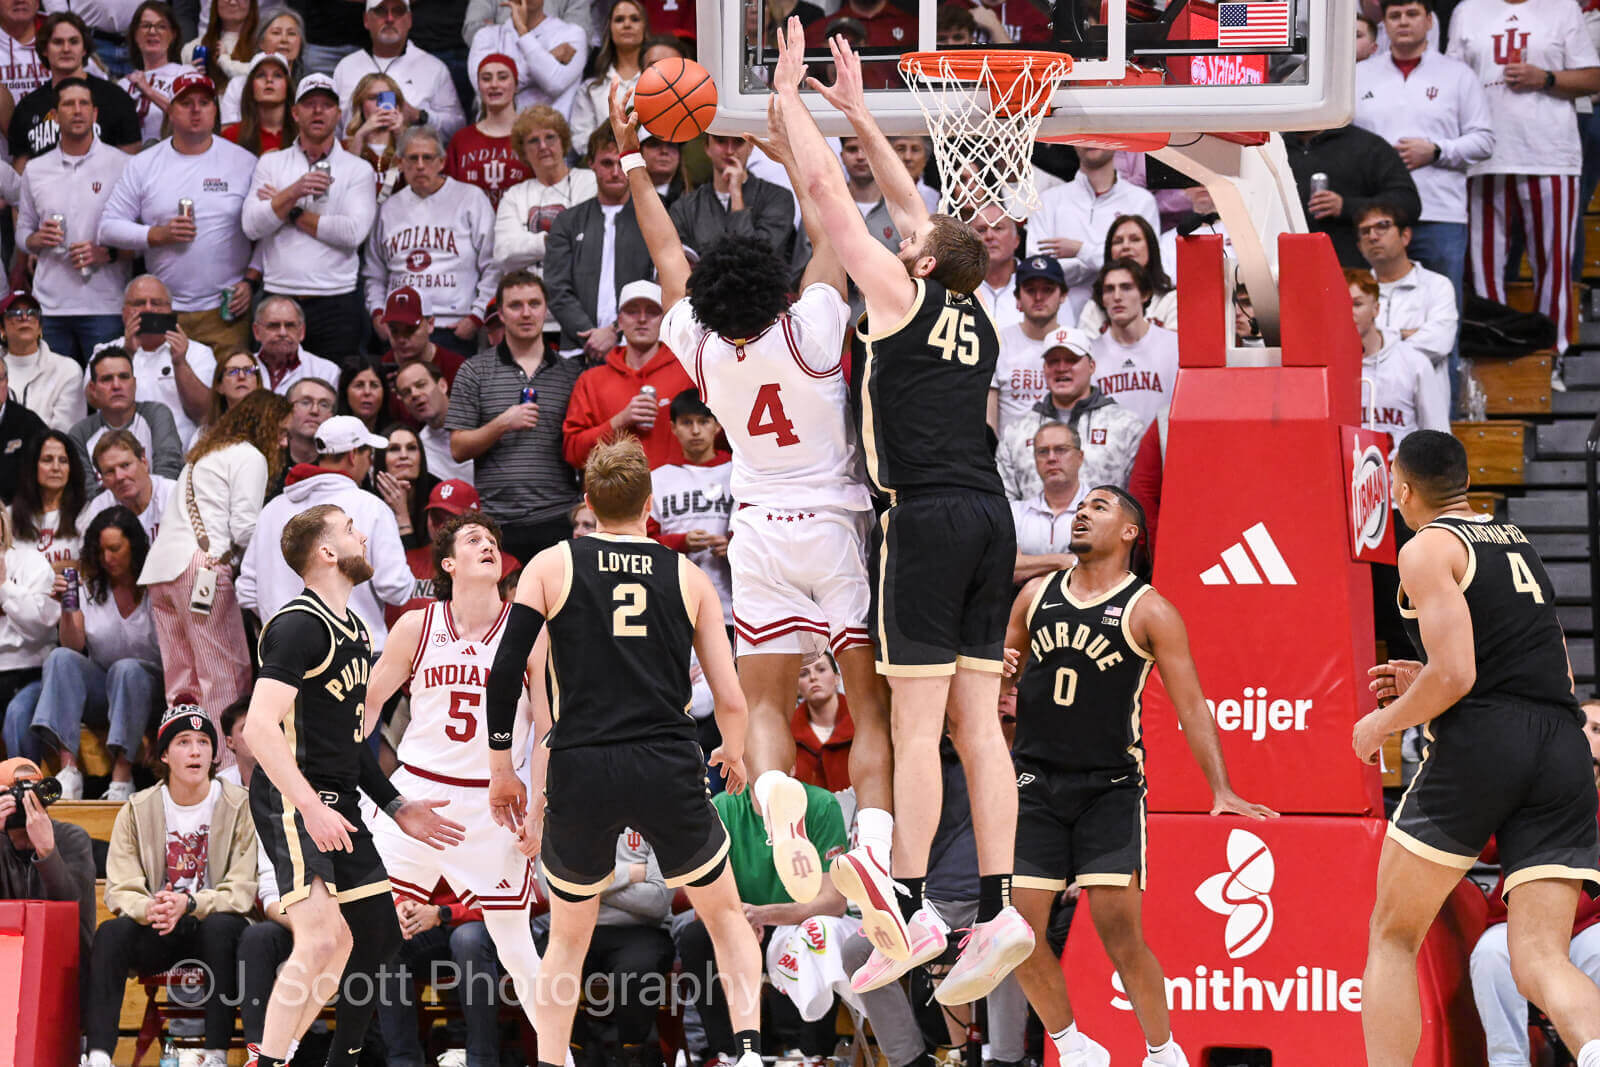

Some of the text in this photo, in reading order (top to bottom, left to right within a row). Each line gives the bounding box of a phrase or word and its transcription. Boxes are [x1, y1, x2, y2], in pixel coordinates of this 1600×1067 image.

[927, 305, 980, 366] 45
[1097, 371, 1163, 395] INDIANA
[746, 383, 800, 447] 4
[598, 550, 654, 575] LOYER
[1506, 552, 1545, 604] 4
[612, 583, 648, 637] 2
[435, 633, 446, 643] 76
[1031, 621, 1124, 671] PURDUE
[1053, 666, 1079, 706] 0
[353, 702, 365, 743] 3
[445, 691, 481, 743] 5
[1110, 965, 1364, 1013] Smithville
